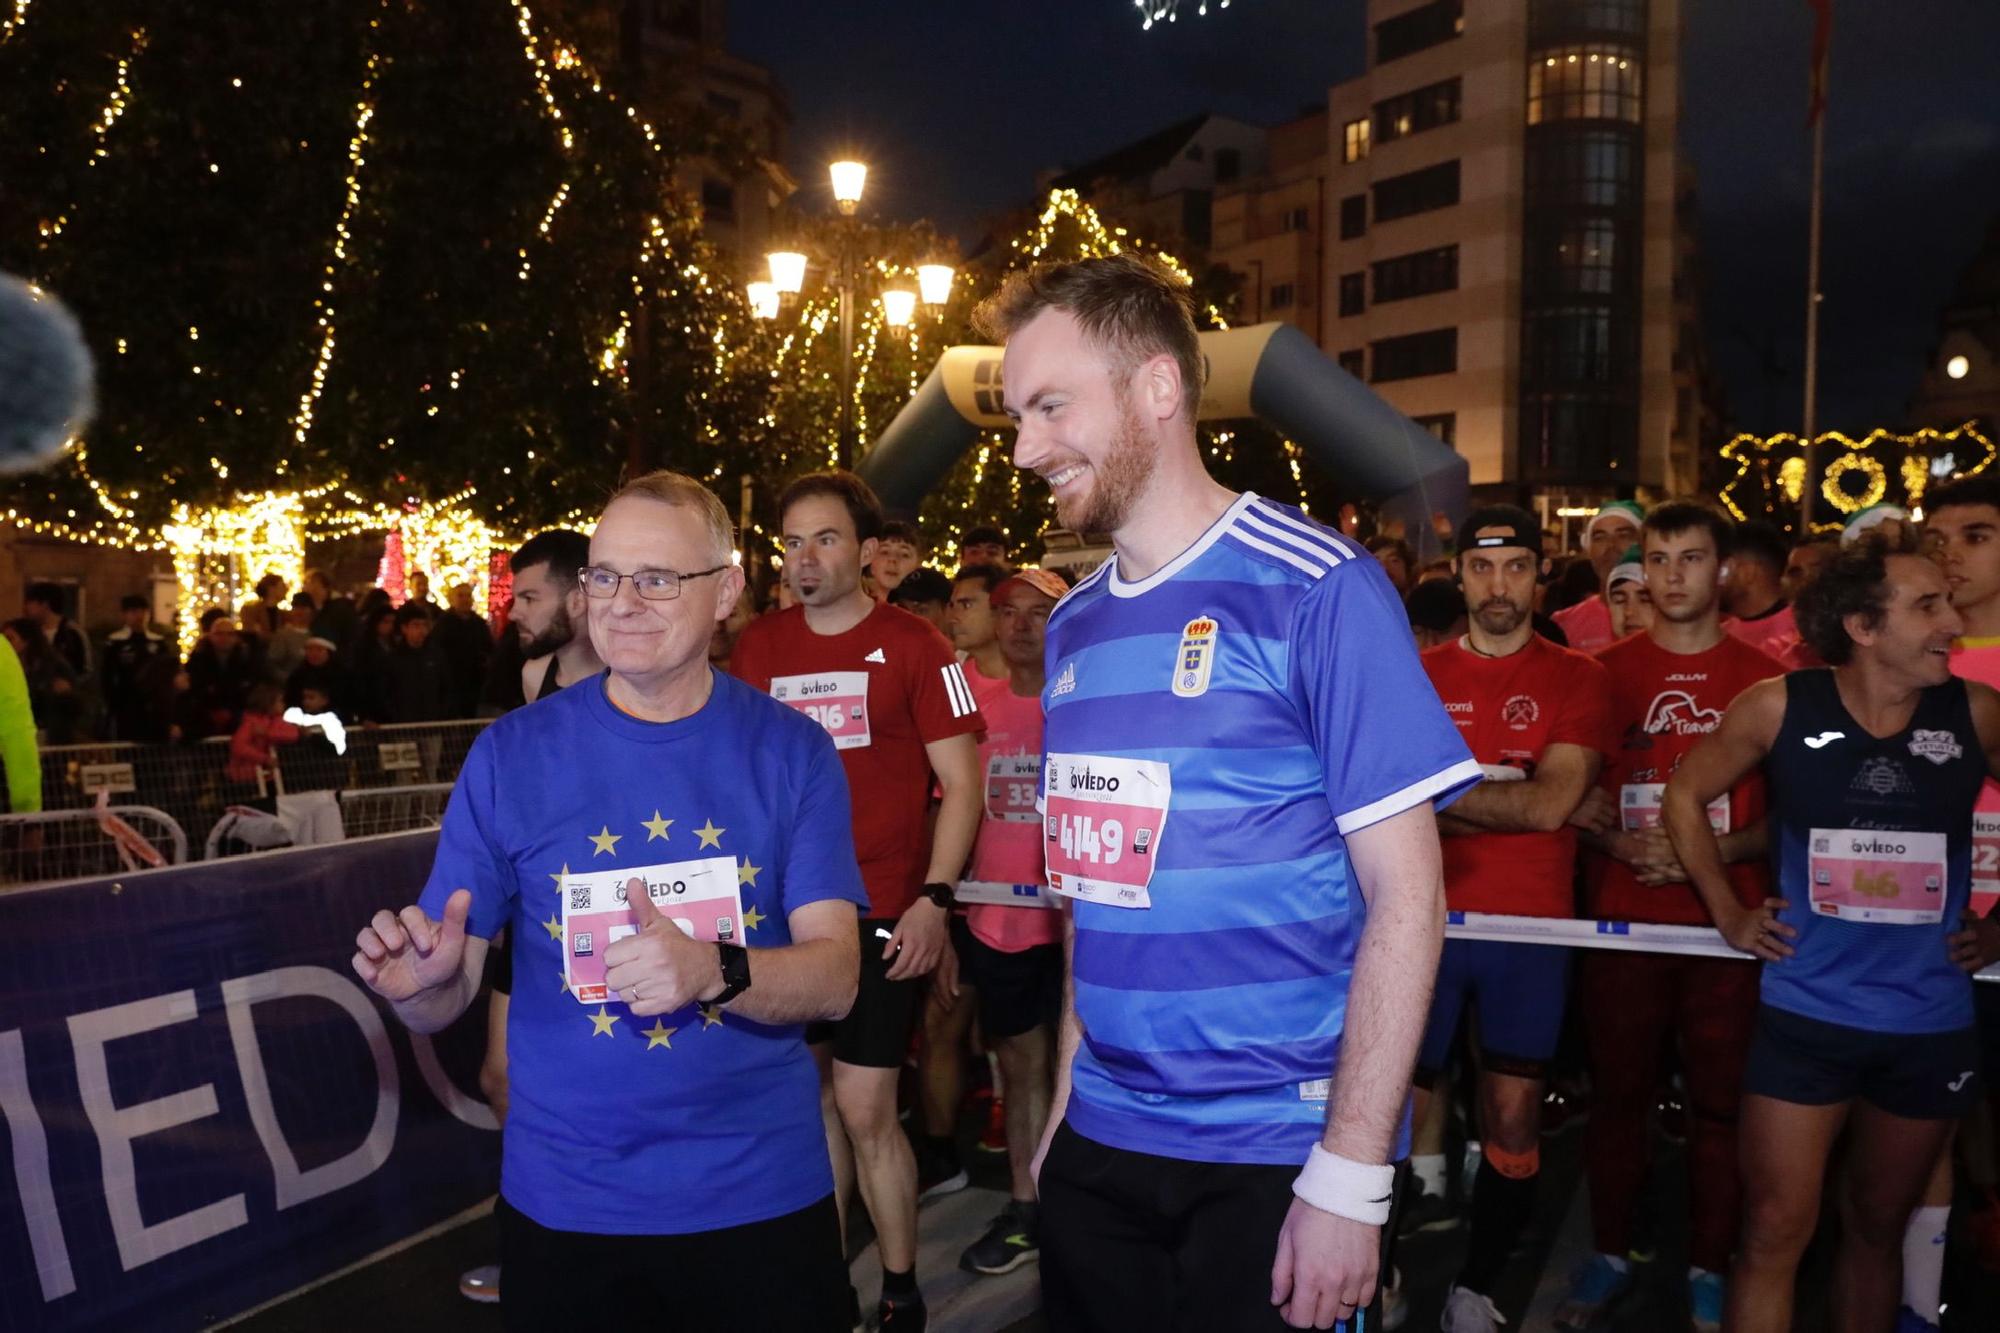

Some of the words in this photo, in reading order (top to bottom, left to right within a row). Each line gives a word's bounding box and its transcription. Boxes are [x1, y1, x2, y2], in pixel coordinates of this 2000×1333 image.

[1069, 764, 1120, 793] OVIEDO
[1060, 813, 1124, 864] 4149
[1852, 838, 1906, 854] OVIEDO
